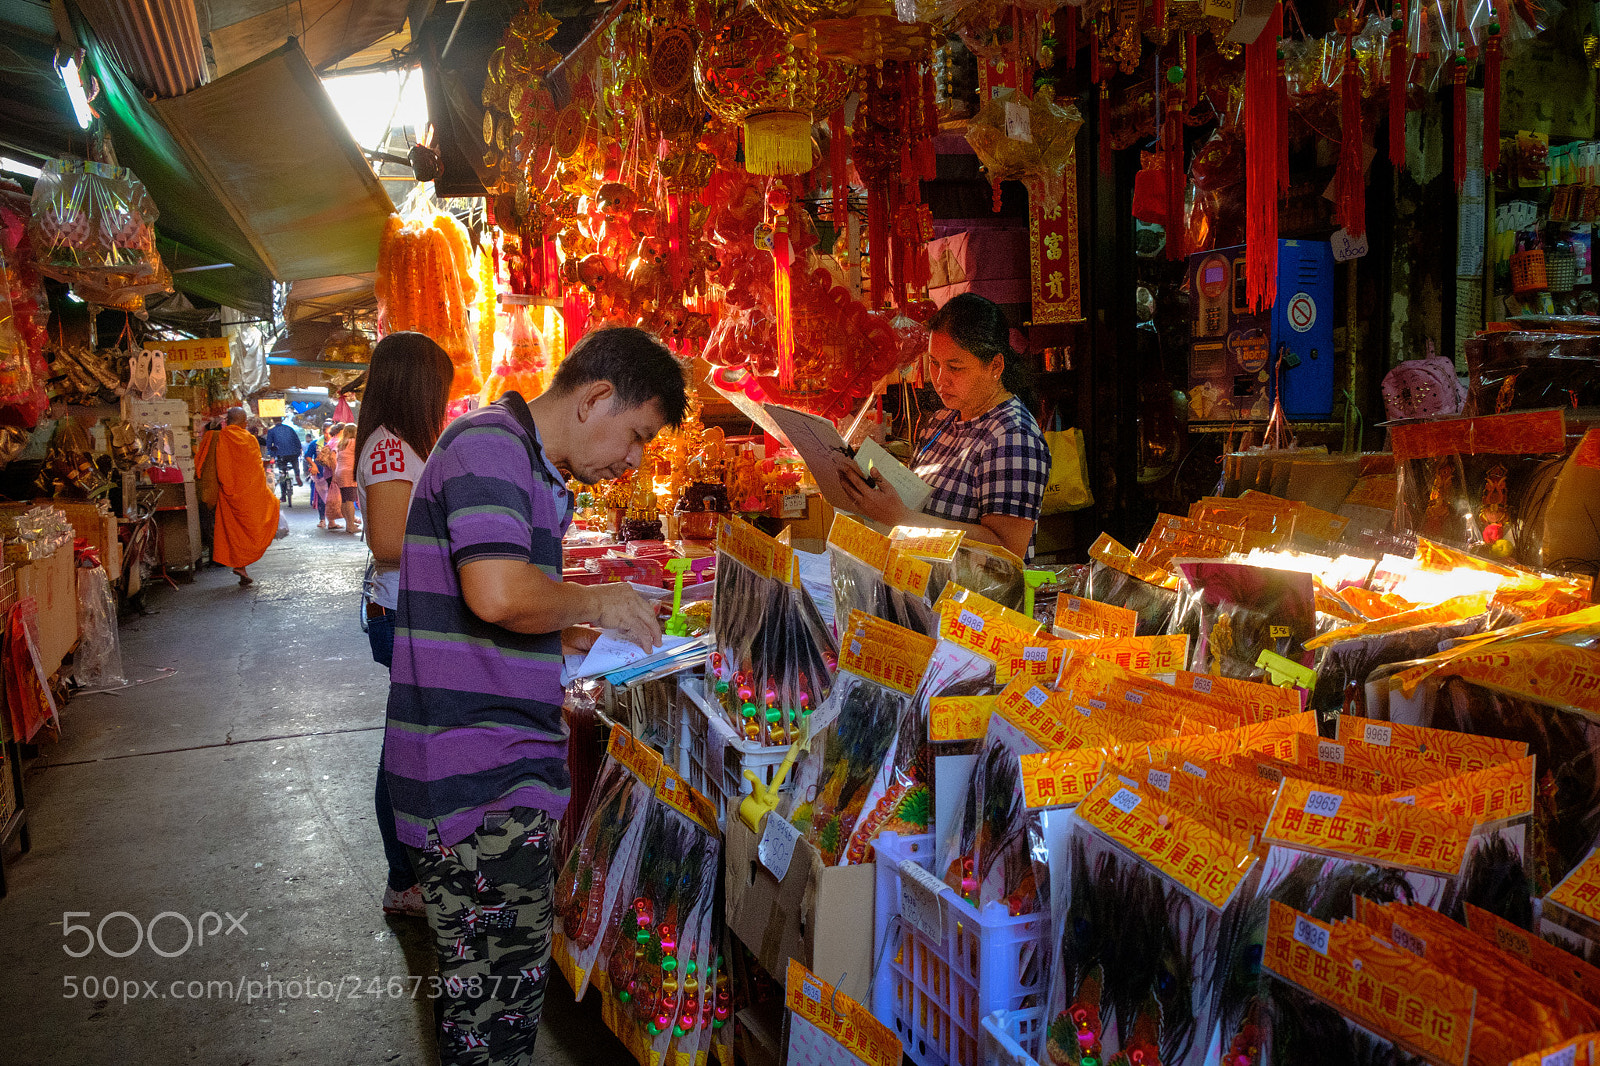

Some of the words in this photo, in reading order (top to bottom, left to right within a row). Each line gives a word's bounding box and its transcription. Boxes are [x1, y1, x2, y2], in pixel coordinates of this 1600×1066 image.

[373, 438, 402, 451] TEAM
[370, 449, 405, 475] 23
[1047, 484, 1061, 492] KE
[961, 613, 983, 632] 9986
[1024, 651, 1046, 661] 9986
[1195, 678, 1212, 692] 9635
[1366, 727, 1389, 743] 9965
[1319, 745, 1341, 761] 9965
[1149, 773, 1168, 789] 9965
[1115, 791, 1138, 810] 9965
[1307, 794, 1338, 812] 9965
[1298, 921, 1326, 949] 9936
[804, 982, 819, 1000] 9635
